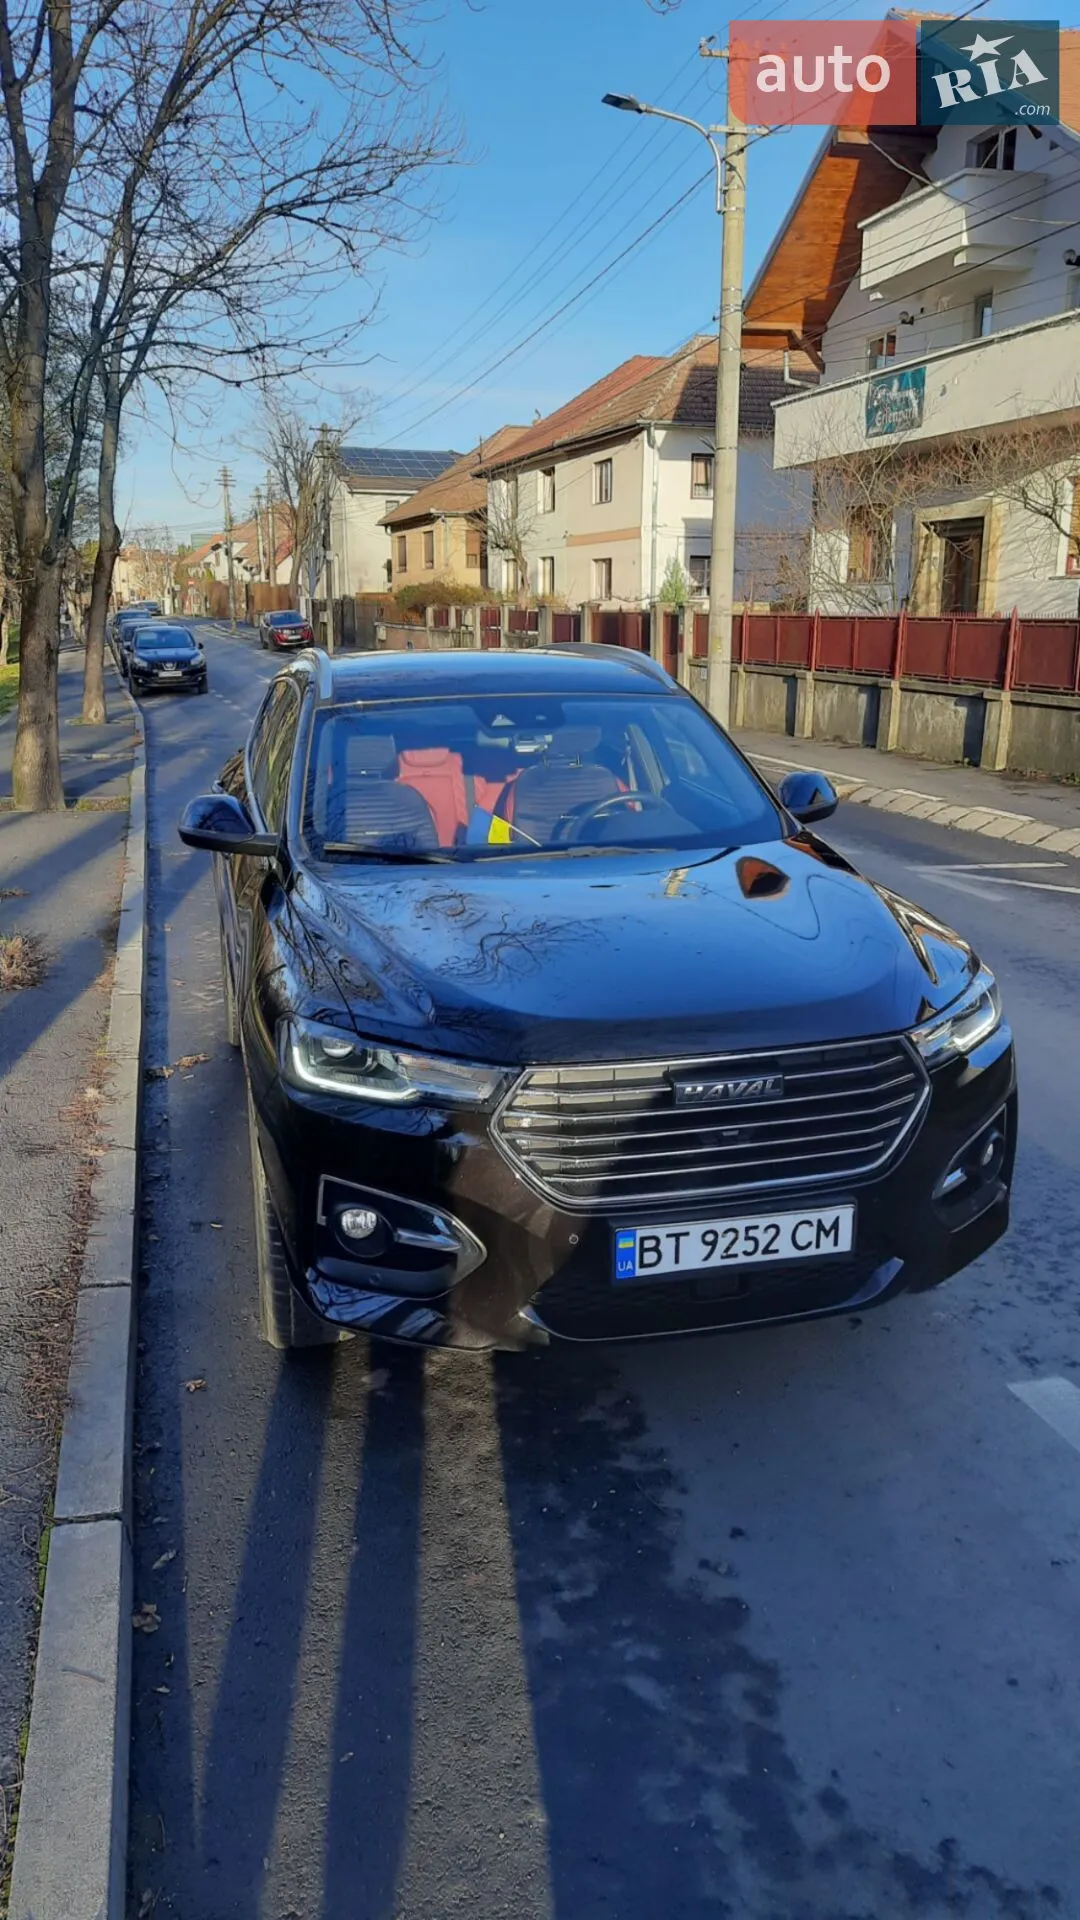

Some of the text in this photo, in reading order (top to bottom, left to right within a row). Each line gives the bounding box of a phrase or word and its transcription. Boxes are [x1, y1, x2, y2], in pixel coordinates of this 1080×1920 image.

[684, 1079, 781, 1101] HAVAL
[638, 1215, 840, 1269] BT 9252 CM
[617, 1261, 634, 1272] UA
